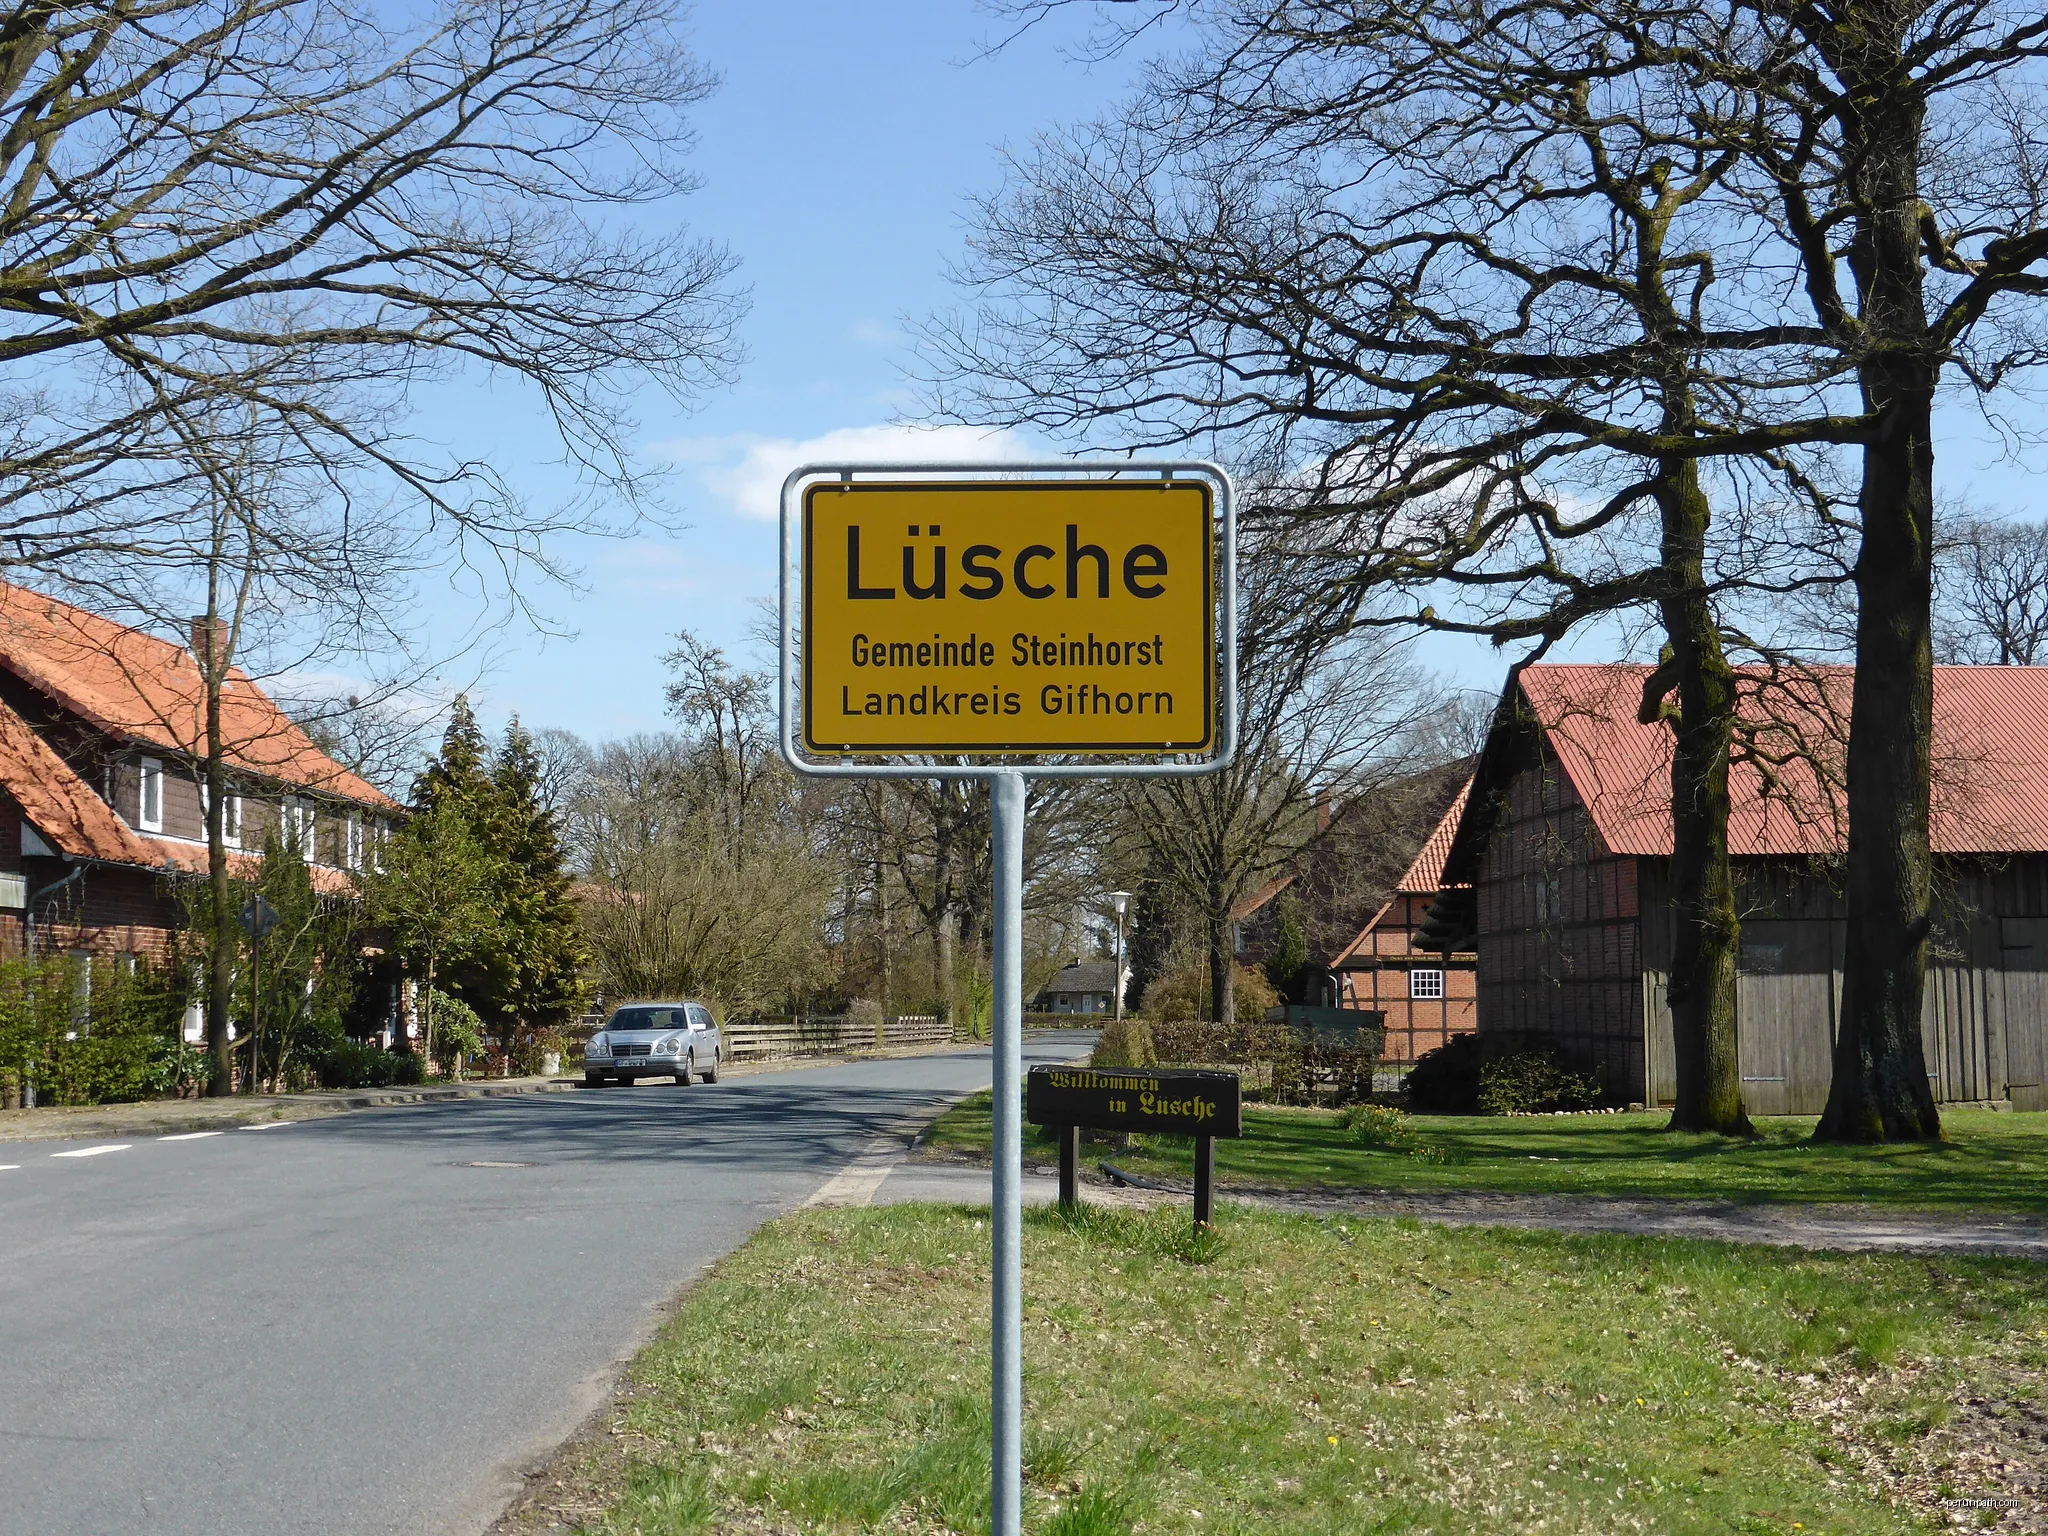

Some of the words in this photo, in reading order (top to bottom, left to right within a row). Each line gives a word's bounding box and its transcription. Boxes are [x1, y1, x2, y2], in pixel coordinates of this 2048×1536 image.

[847, 523, 1168, 600] Lüsche
[851, 632, 995, 668] Gemeinde
[1011, 631, 1163, 667] Steinhorst
[842, 684, 1021, 717] Landkreis
[1040, 683, 1173, 716] Gifhorn
[1049, 1071, 1160, 1092] Willkommen
[1108, 1096, 1127, 1113] in
[1139, 1091, 1217, 1123] Lüsche
